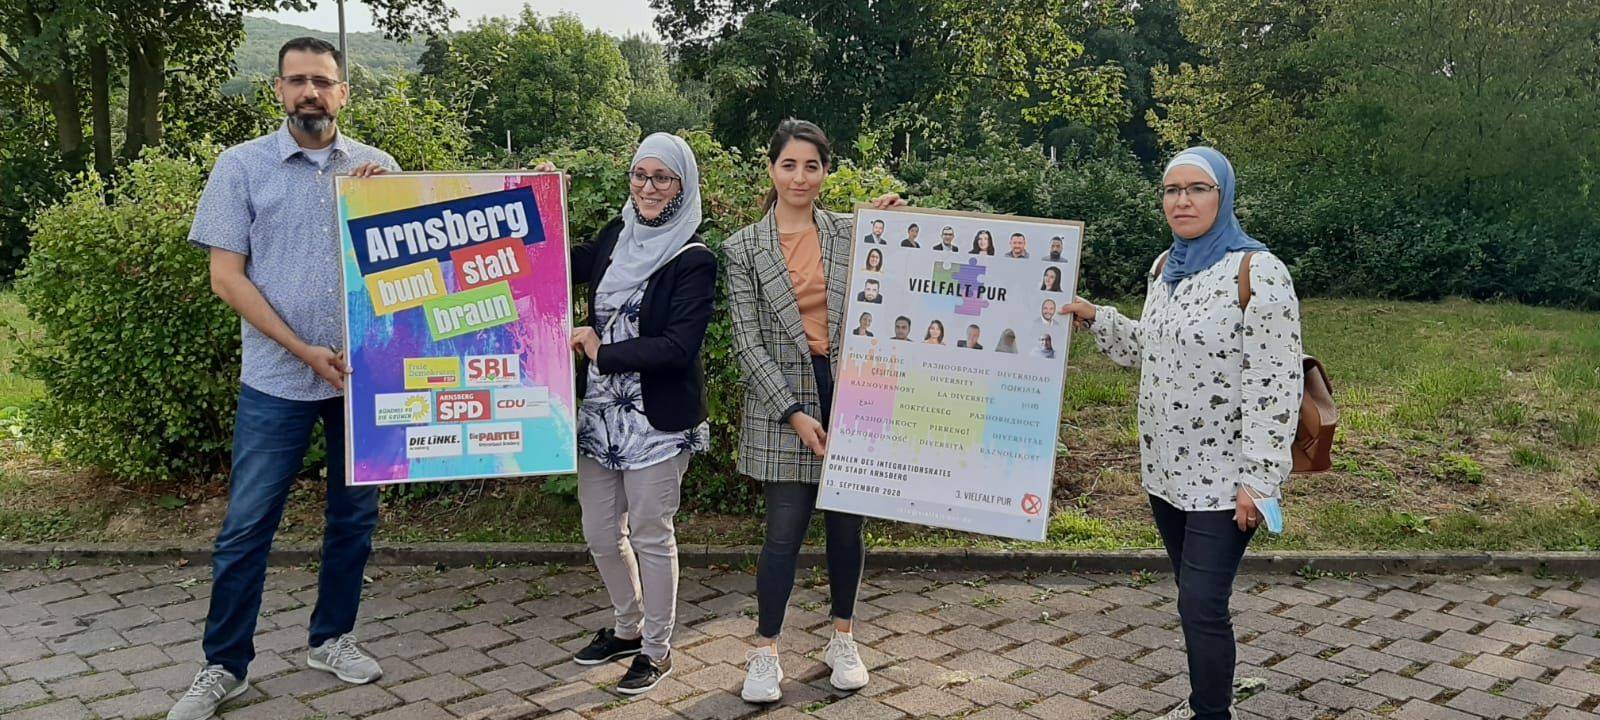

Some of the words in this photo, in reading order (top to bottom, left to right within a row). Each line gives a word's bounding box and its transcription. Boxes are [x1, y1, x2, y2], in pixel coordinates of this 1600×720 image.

[365, 201, 529, 263] Arnsberg
[378, 268, 438, 307] bunt
[462, 247, 520, 285] statt
[909, 278, 971, 298] VIELFALT
[976, 285, 1007, 302] PUR
[432, 294, 512, 335] braun
[468, 358, 515, 379] SBL
[997, 370, 1051, 383] DIVERSIDAD
[930, 375, 973, 387] DIVERSITY
[439, 393, 474, 401] ARNSBERG
[496, 399, 526, 408] CDU
[440, 401, 484, 421] SPD
[409, 437, 425, 446] DIE
[829, 463, 842, 471] DER
[845, 466, 867, 475] STADT
[870, 470, 908, 481] ARNSBERG
[831, 454, 858, 464] WAHLEN
[861, 458, 874, 466] DES
[877, 460, 952, 478] INTEGRATIONSRATES
[839, 481, 880, 493] SEPTEMBER
[883, 487, 901, 496] 2020
[964, 492, 995, 504] VIELFALT
[997, 497, 1012, 506] PUR
